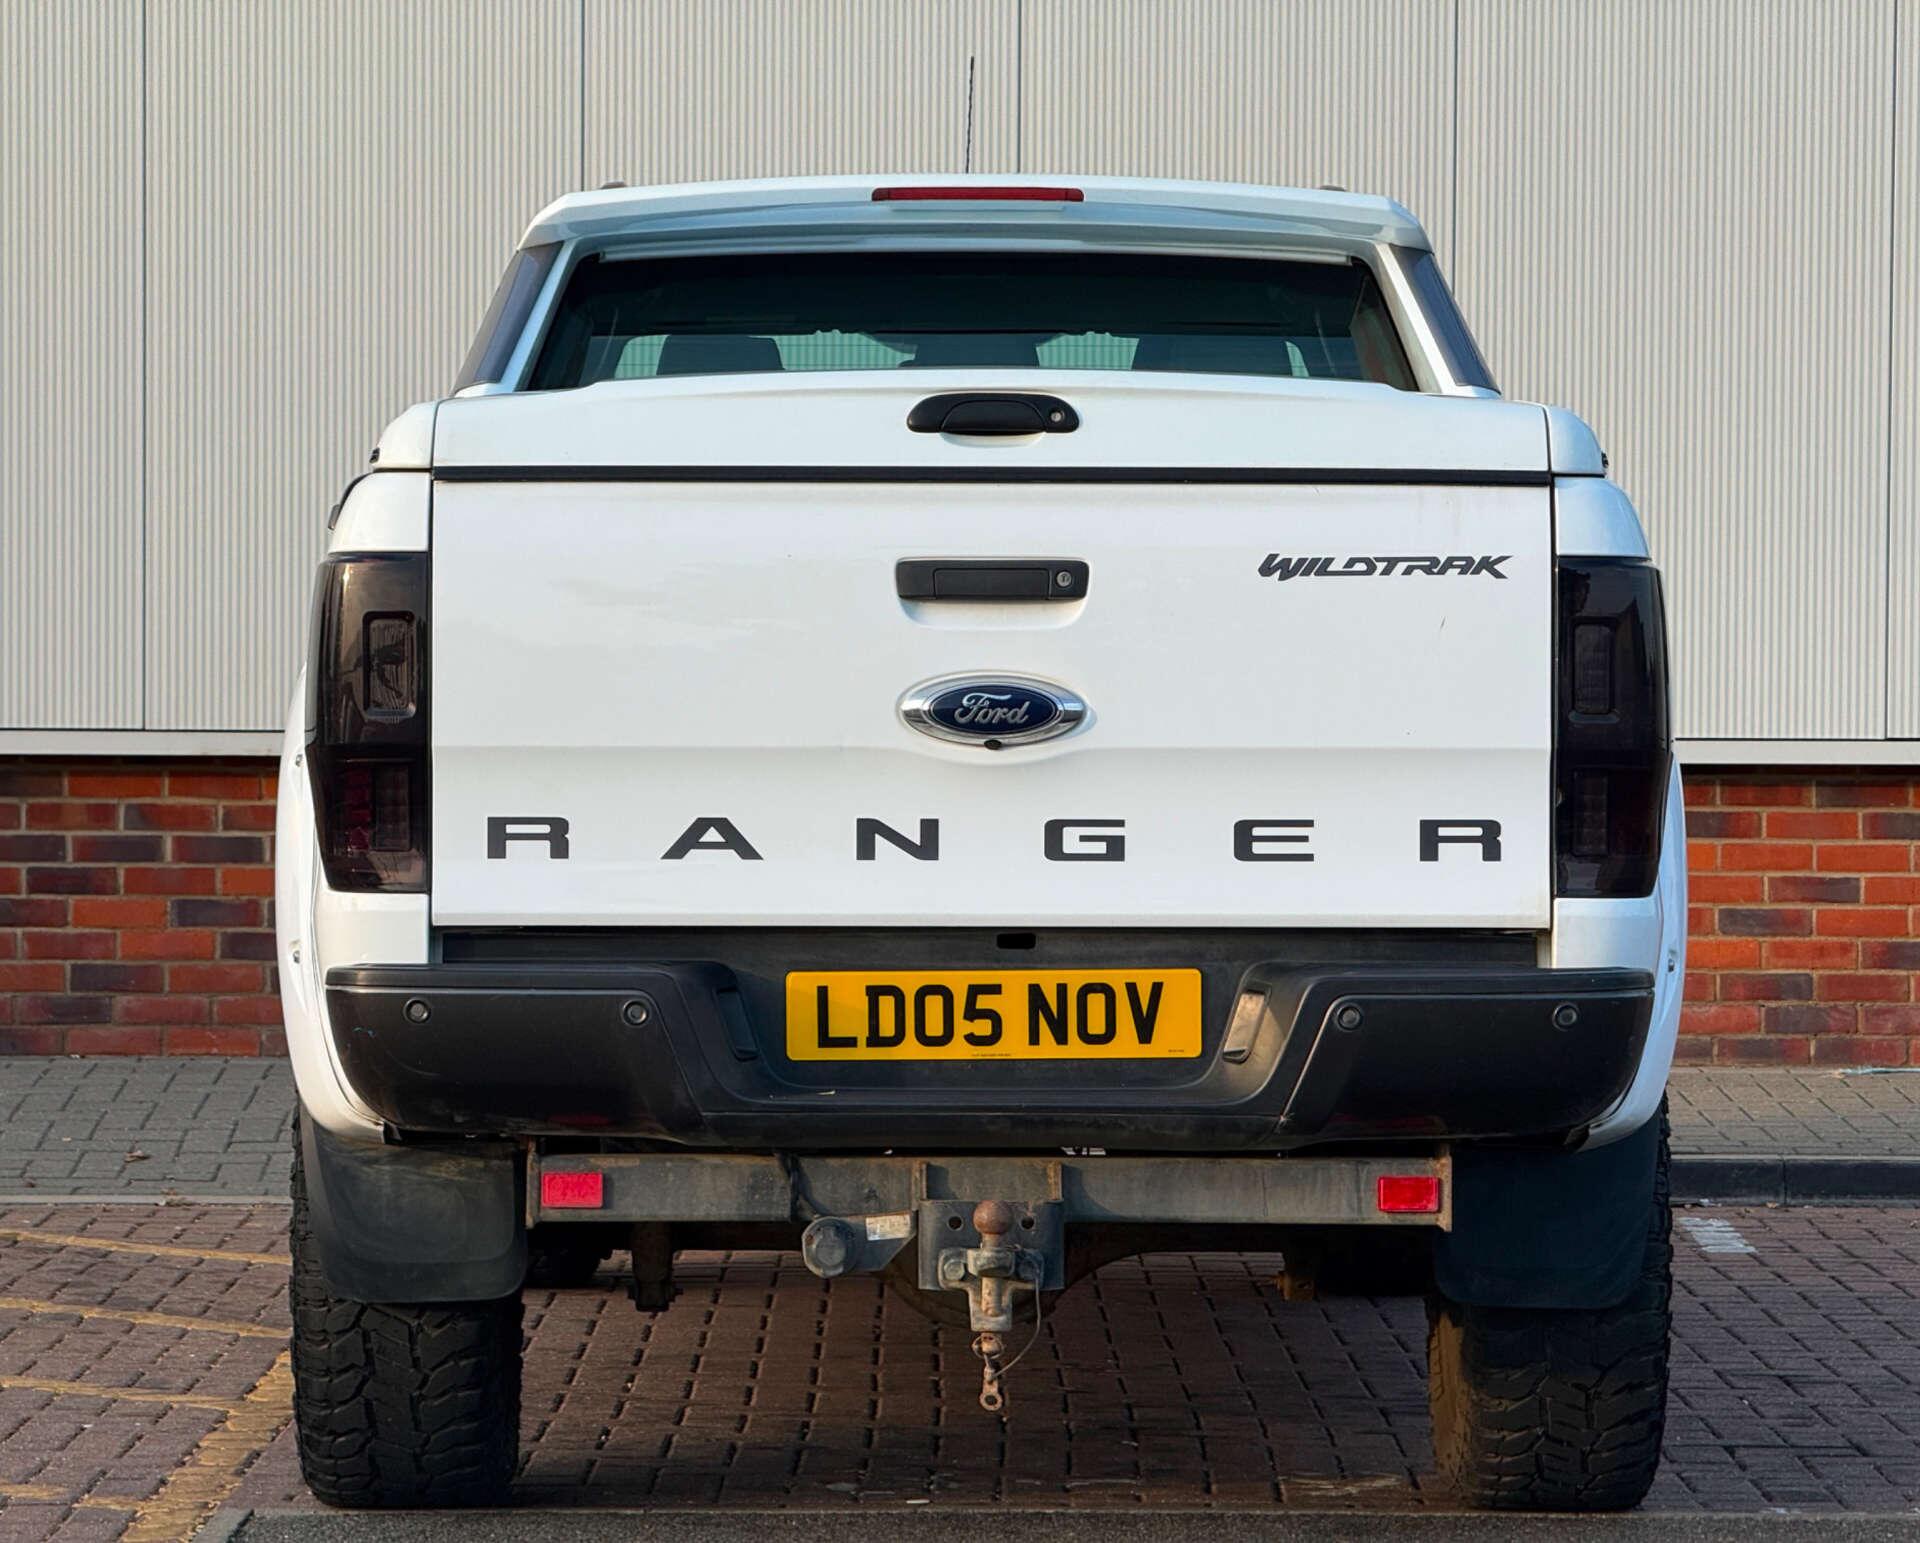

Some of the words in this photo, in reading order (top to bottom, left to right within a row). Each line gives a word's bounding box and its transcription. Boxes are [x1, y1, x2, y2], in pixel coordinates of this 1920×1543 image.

[1258, 553, 1513, 581] WILDTRAK
[954, 691, 1030, 725] Ford
[487, 816, 1502, 862] RANGER
[1027, 981, 1164, 1047] NOV
